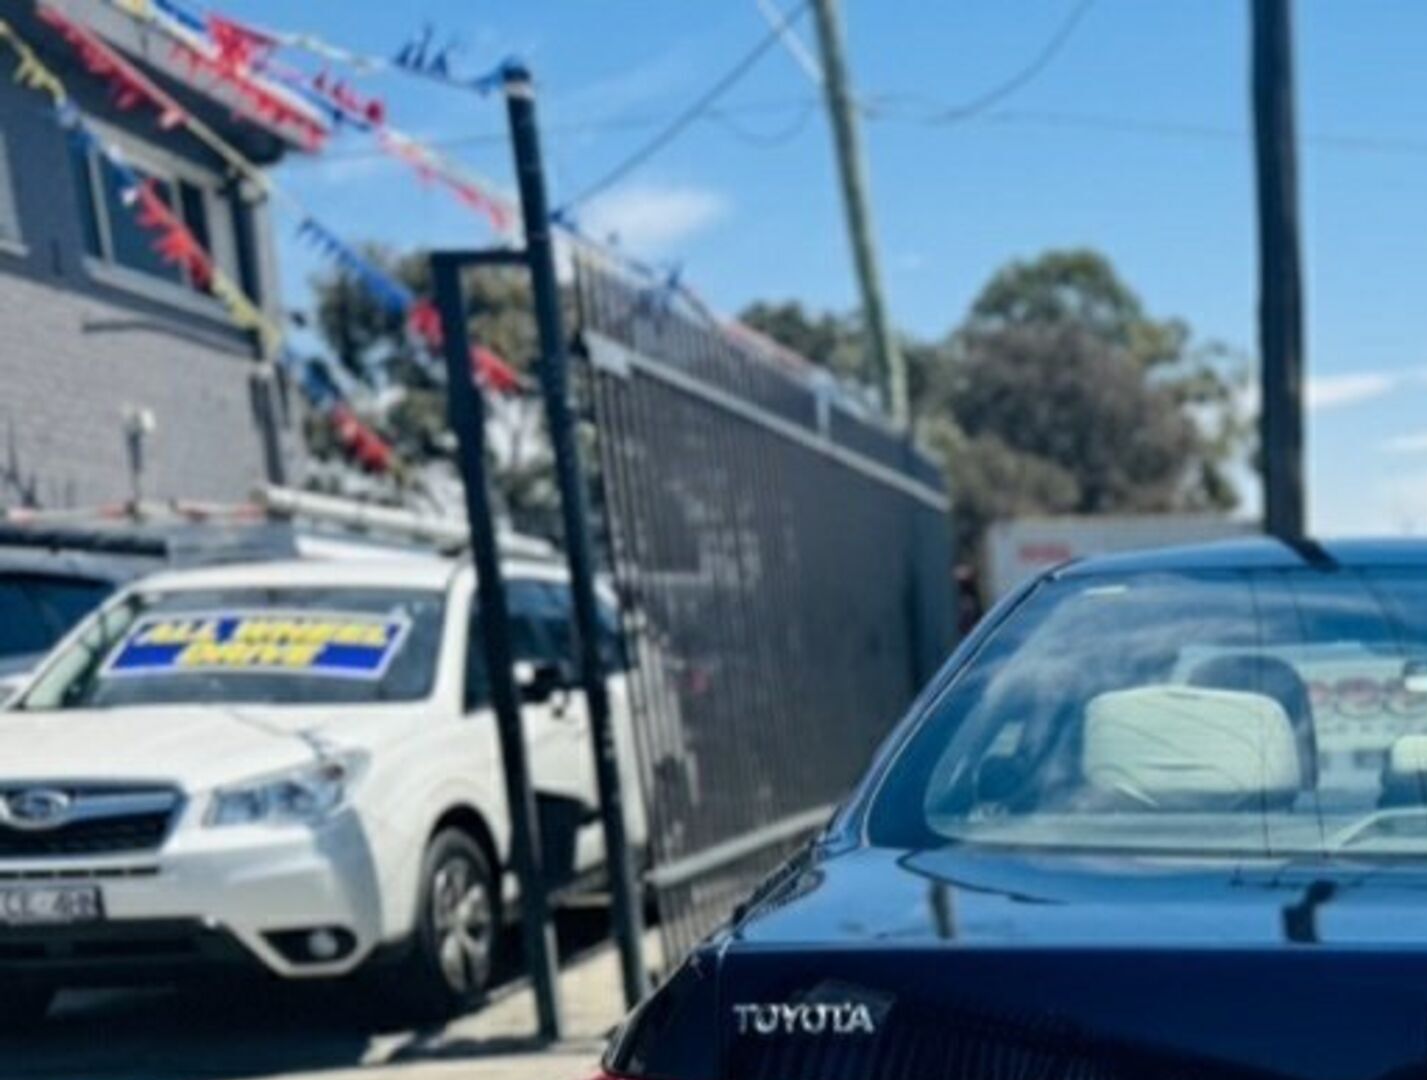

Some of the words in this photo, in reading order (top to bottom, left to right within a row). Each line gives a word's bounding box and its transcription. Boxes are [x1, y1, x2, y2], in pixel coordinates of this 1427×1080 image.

[135, 620, 220, 646] ALL
[174, 641, 326, 667] DRIVE
[733, 1003, 874, 1035] TOYOTA
